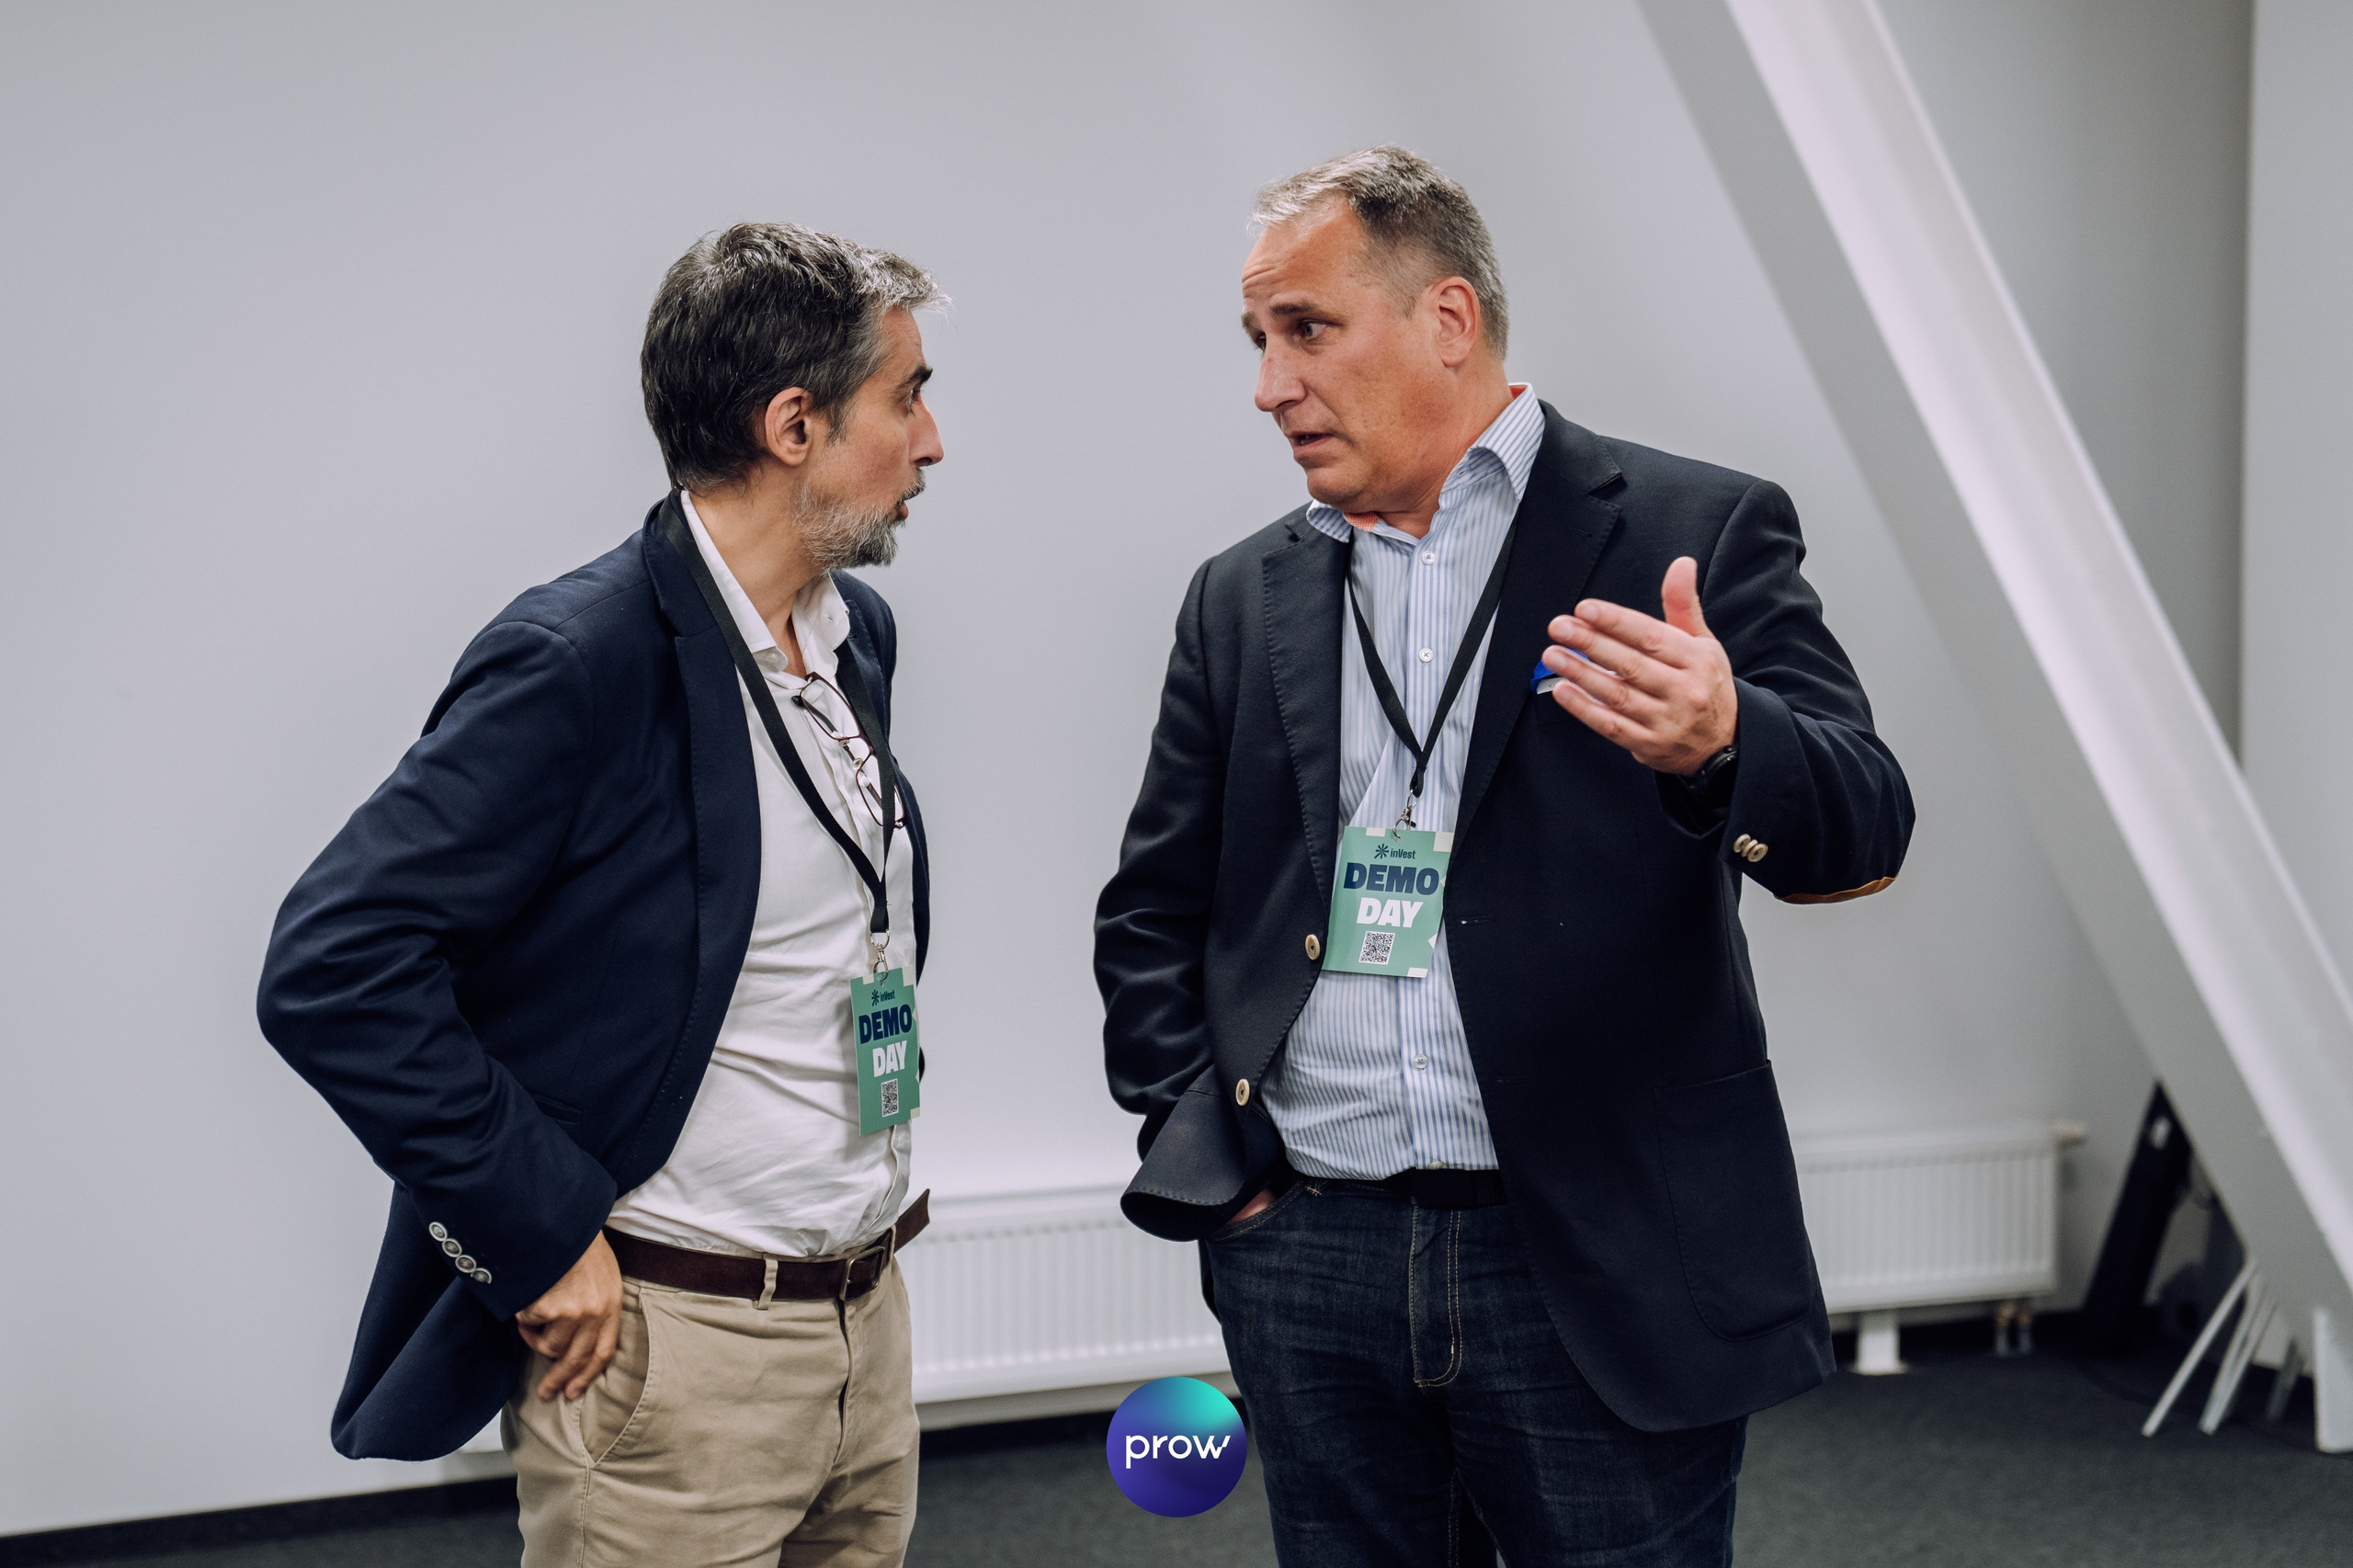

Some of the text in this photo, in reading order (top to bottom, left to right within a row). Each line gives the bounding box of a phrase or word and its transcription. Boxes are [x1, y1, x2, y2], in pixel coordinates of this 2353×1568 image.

[1390, 848, 1416, 859] inVest
[1343, 862, 1439, 895] DEMO
[1357, 897, 1424, 928] DAY
[858, 1004, 913, 1044] DEMO
[872, 1040, 907, 1077] DAY
